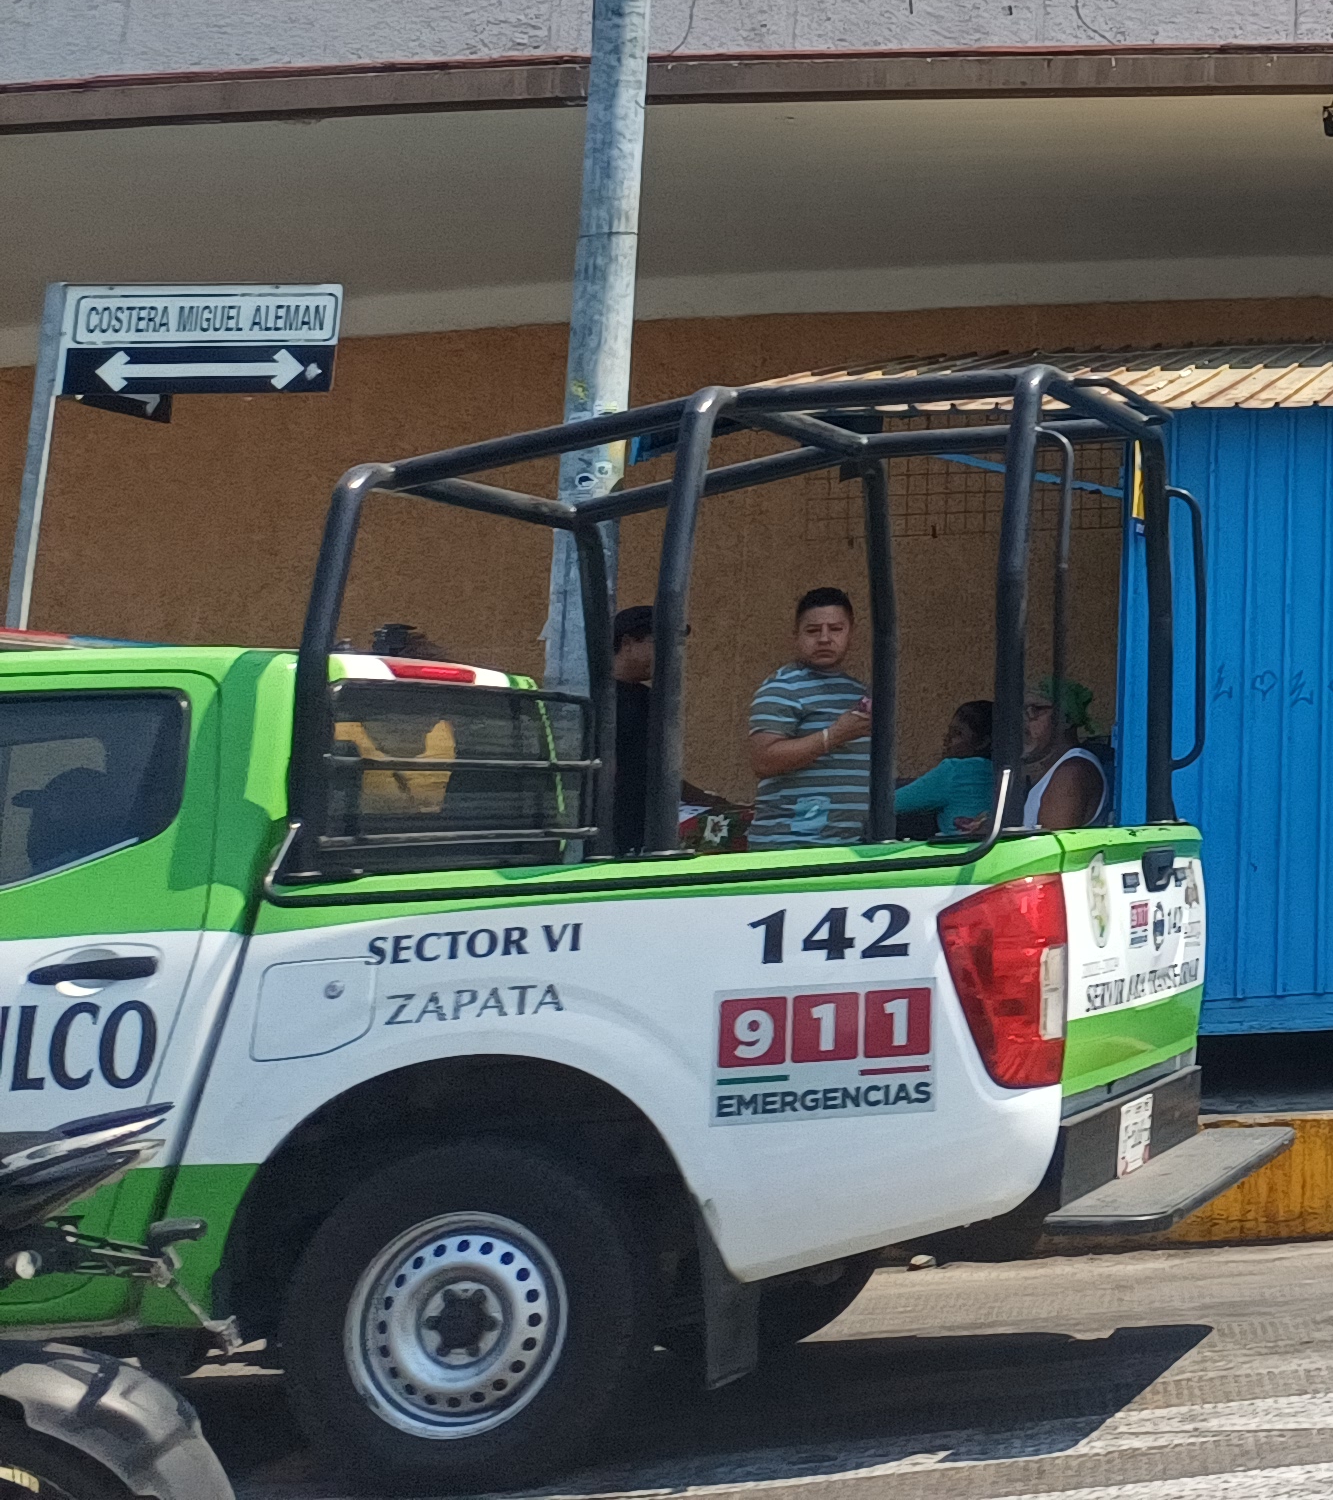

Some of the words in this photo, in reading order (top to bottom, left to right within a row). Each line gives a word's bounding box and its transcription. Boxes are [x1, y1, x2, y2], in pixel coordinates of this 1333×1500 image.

[86, 305, 171, 334] COSTERA
[176, 305, 243, 333] MIGUEL
[249, 304, 328, 332] ALEMAN
[364, 926, 529, 966] SECTOR
[541, 922, 583, 954] VI
[747, 903, 911, 965] 142
[384, 983, 566, 1027] ZAPATA
[733, 998, 910, 1060] 911
[715, 1081, 933, 1118] EMERGENCIAS
